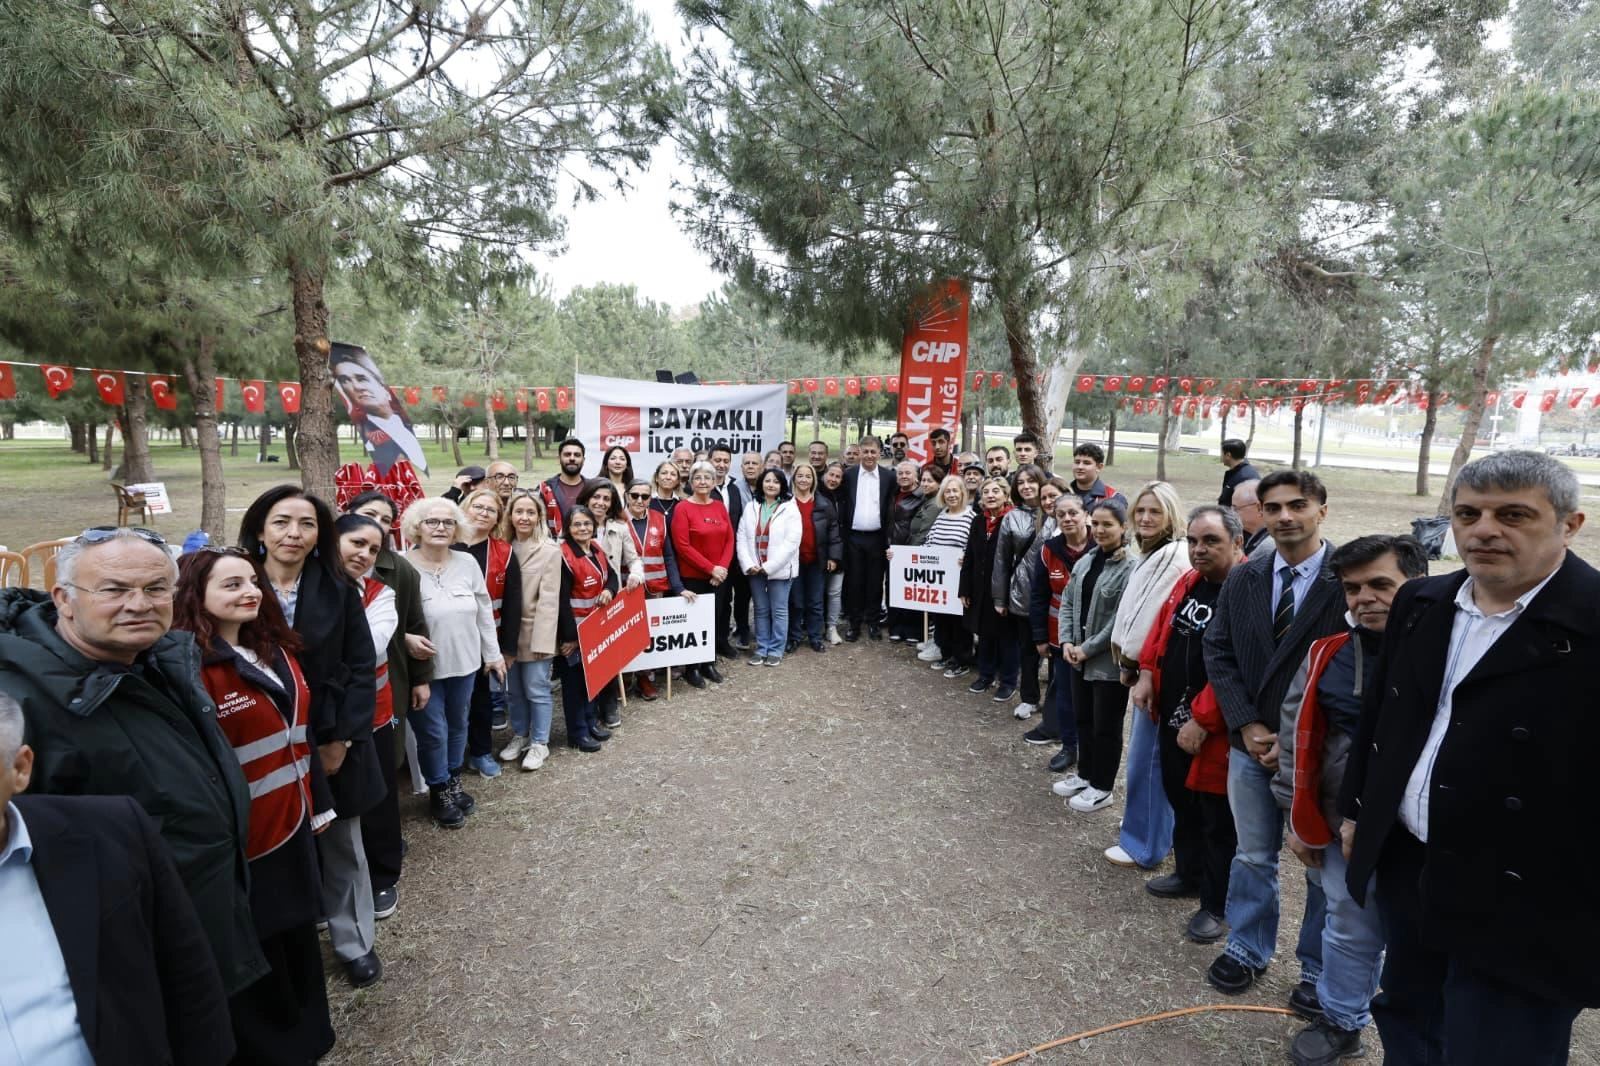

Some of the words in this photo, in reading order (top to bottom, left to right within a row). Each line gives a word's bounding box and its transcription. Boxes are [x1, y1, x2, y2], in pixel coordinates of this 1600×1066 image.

[911, 340, 961, 363] CHP
[648, 407, 763, 432] BAYRAKLI
[605, 435, 635, 447] CHP
[904, 567, 945, 585] UMUT
[904, 584, 939, 604] BİZİZ
[219, 695, 248, 709] BAYRAKLI
[224, 692, 238, 700] CHP
